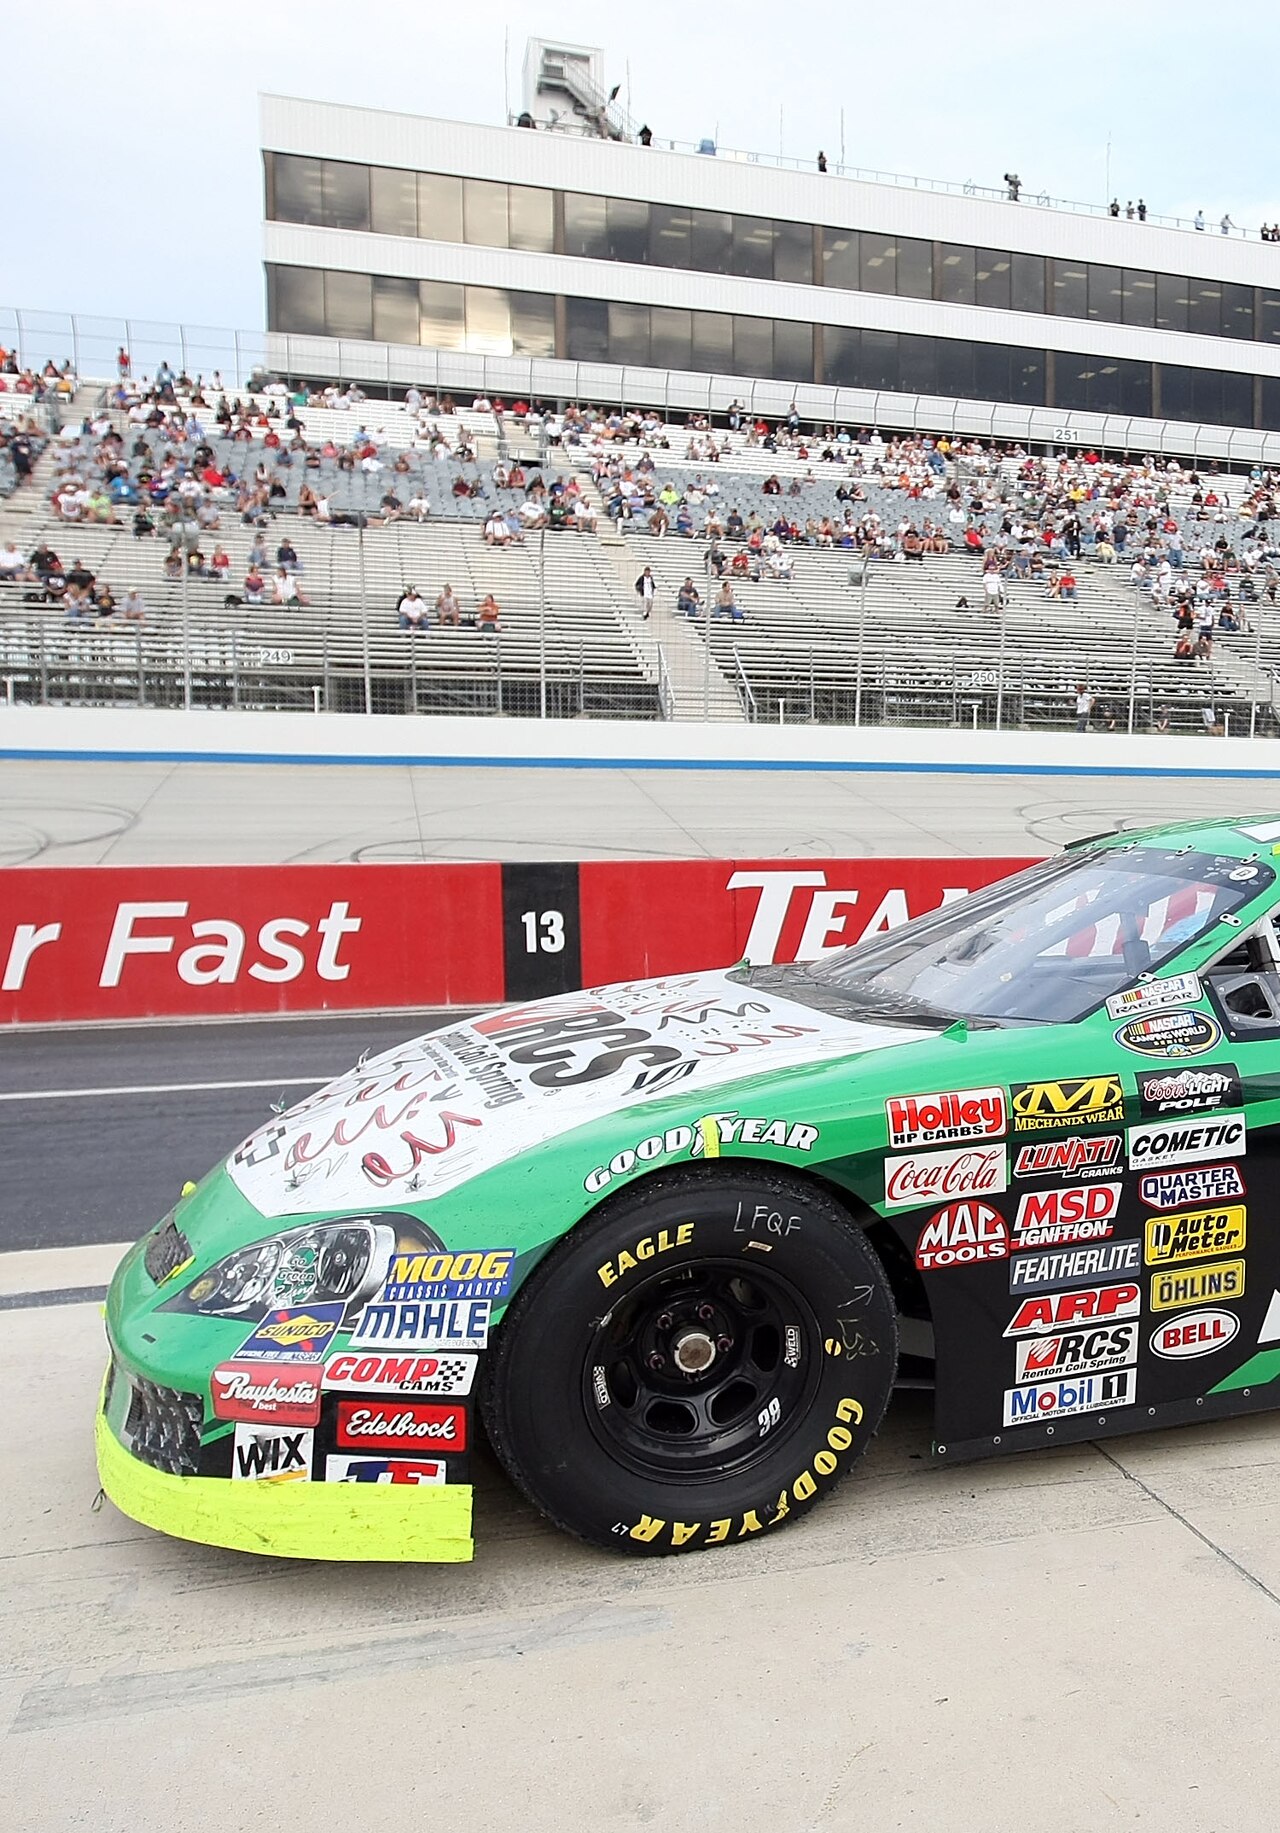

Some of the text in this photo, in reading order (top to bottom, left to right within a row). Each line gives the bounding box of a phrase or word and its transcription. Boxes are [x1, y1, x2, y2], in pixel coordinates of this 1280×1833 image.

[1055, 429, 1079, 441] 251
[261, 650, 292, 663] 249
[971, 671, 996, 682] 250
[100, 901, 363, 988] Fast
[520, 911, 566, 954] 13
[1141, 979, 1184, 998] NASCAR
[1116, 992, 1194, 1014] RACE CAR
[1130, 1025, 1207, 1043] CAMPING WORLD
[1148, 1013, 1193, 1034] NASCAR
[494, 1008, 685, 1088] RCS
[1153, 1037, 1191, 1046] SERIES
[454, 1044, 500, 1066] Coil
[465, 1061, 526, 1110] Spring
[1144, 1077, 1233, 1102] Coors LIGHT
[891, 1095, 1003, 1134] Holley
[1158, 1096, 1222, 1112] POLE
[1014, 1107, 1125, 1132] MECHANIX WEAR
[893, 1125, 984, 1145] HP CARBS
[1132, 1123, 1243, 1157] COMETIC
[1018, 1138, 1116, 1171] LUNATI
[1132, 1153, 1176, 1164] GASKET
[888, 1150, 1004, 1200] Coca-Cola
[1080, 1166, 1125, 1179] CRANKS
[1143, 1167, 1235, 1198] QUARTER
[1160, 1181, 1240, 1206] MASTER
[1022, 1187, 1115, 1228] MSD
[919, 1204, 1006, 1251] MAC
[1018, 1220, 1109, 1247] IGNITION
[1175, 1214, 1228, 1236] Auto
[597, 1221, 695, 1288] EAGLE
[919, 1242, 1007, 1268] TOOLS
[1169, 1229, 1240, 1255] Meter
[1175, 1247, 1214, 1258] PERFORMANCE
[278, 1269, 314, 1283] Green
[391, 1251, 509, 1285] MOOG
[389, 1282, 502, 1301] CHASSIS PARTS
[1160, 1271, 1237, 1303] ÖHLINS
[358, 1301, 488, 1339] MAHLE
[1011, 1285, 1139, 1329] ARP
[259, 1321, 332, 1339] SUNOCO
[1163, 1319, 1226, 1350] BELL
[1056, 1326, 1133, 1366] RCS
[326, 1356, 438, 1385] COMP
[1021, 1355, 1126, 1380] Renton Coil Spring
[214, 1370, 318, 1409] Raybestos
[398, 1380, 454, 1393] CAMS
[1011, 1378, 1093, 1417] Mobil
[258, 1402, 278, 1411] best
[1011, 1412, 1040, 1424] OFFICIAL
[1041, 1408, 1066, 1417] MOTOR
[1086, 1397, 1127, 1410] LUBRICANTS
[346, 1410, 456, 1440] Edelbrock
[237, 1432, 309, 1478] WIX
[629, 1397, 865, 1546] GOODYEAR
